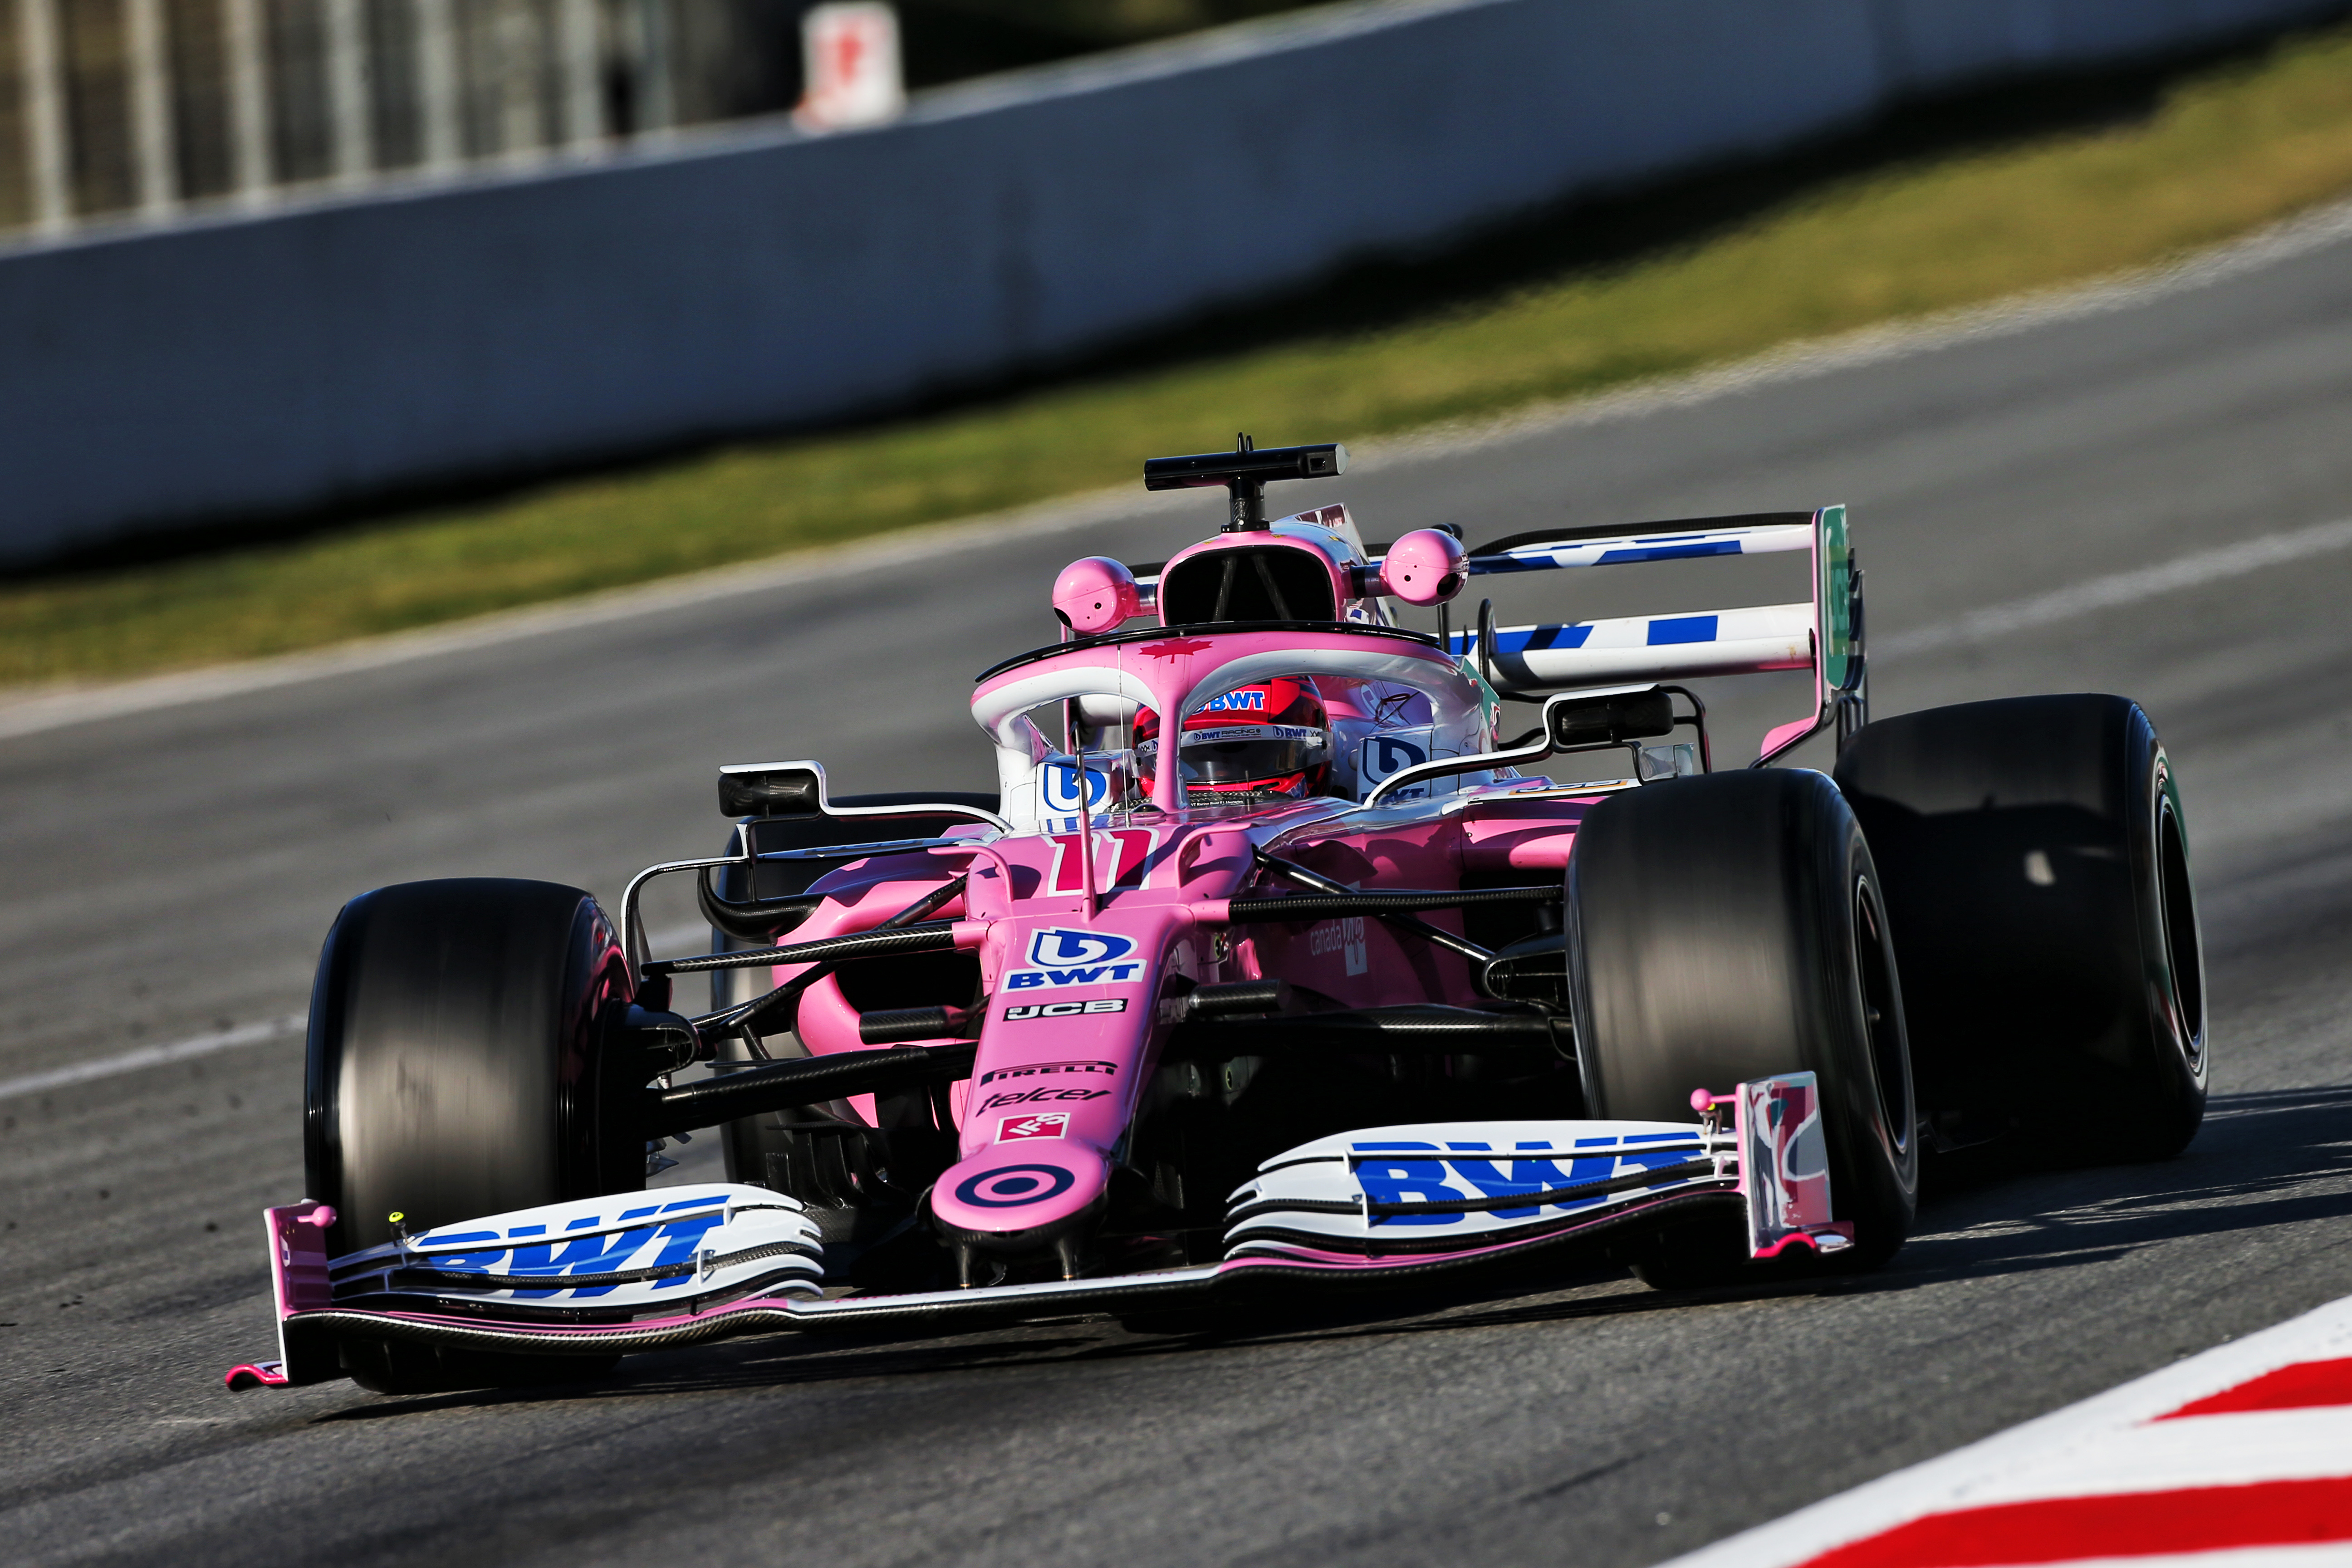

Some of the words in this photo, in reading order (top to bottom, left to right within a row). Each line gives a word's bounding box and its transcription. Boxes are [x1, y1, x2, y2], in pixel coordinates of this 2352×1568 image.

[1210, 691, 1265, 711] BWT
[1201, 731, 1220, 740] BWT
[1284, 728, 1307, 737] BWT
[1519, 780, 1621, 793] JCB
[1040, 828, 1160, 897] 11
[1310, 919, 1343, 956] canada
[1007, 963, 1140, 990] BWT
[1007, 999, 1124, 1020] JCB
[980, 1060, 1118, 1088] PIRELLI
[975, 1087, 1112, 1118] telcel
[1008, 1114, 1067, 1136] IFS
[1350, 1131, 1706, 1226] BWT
[416, 1194, 731, 1299] BWT
